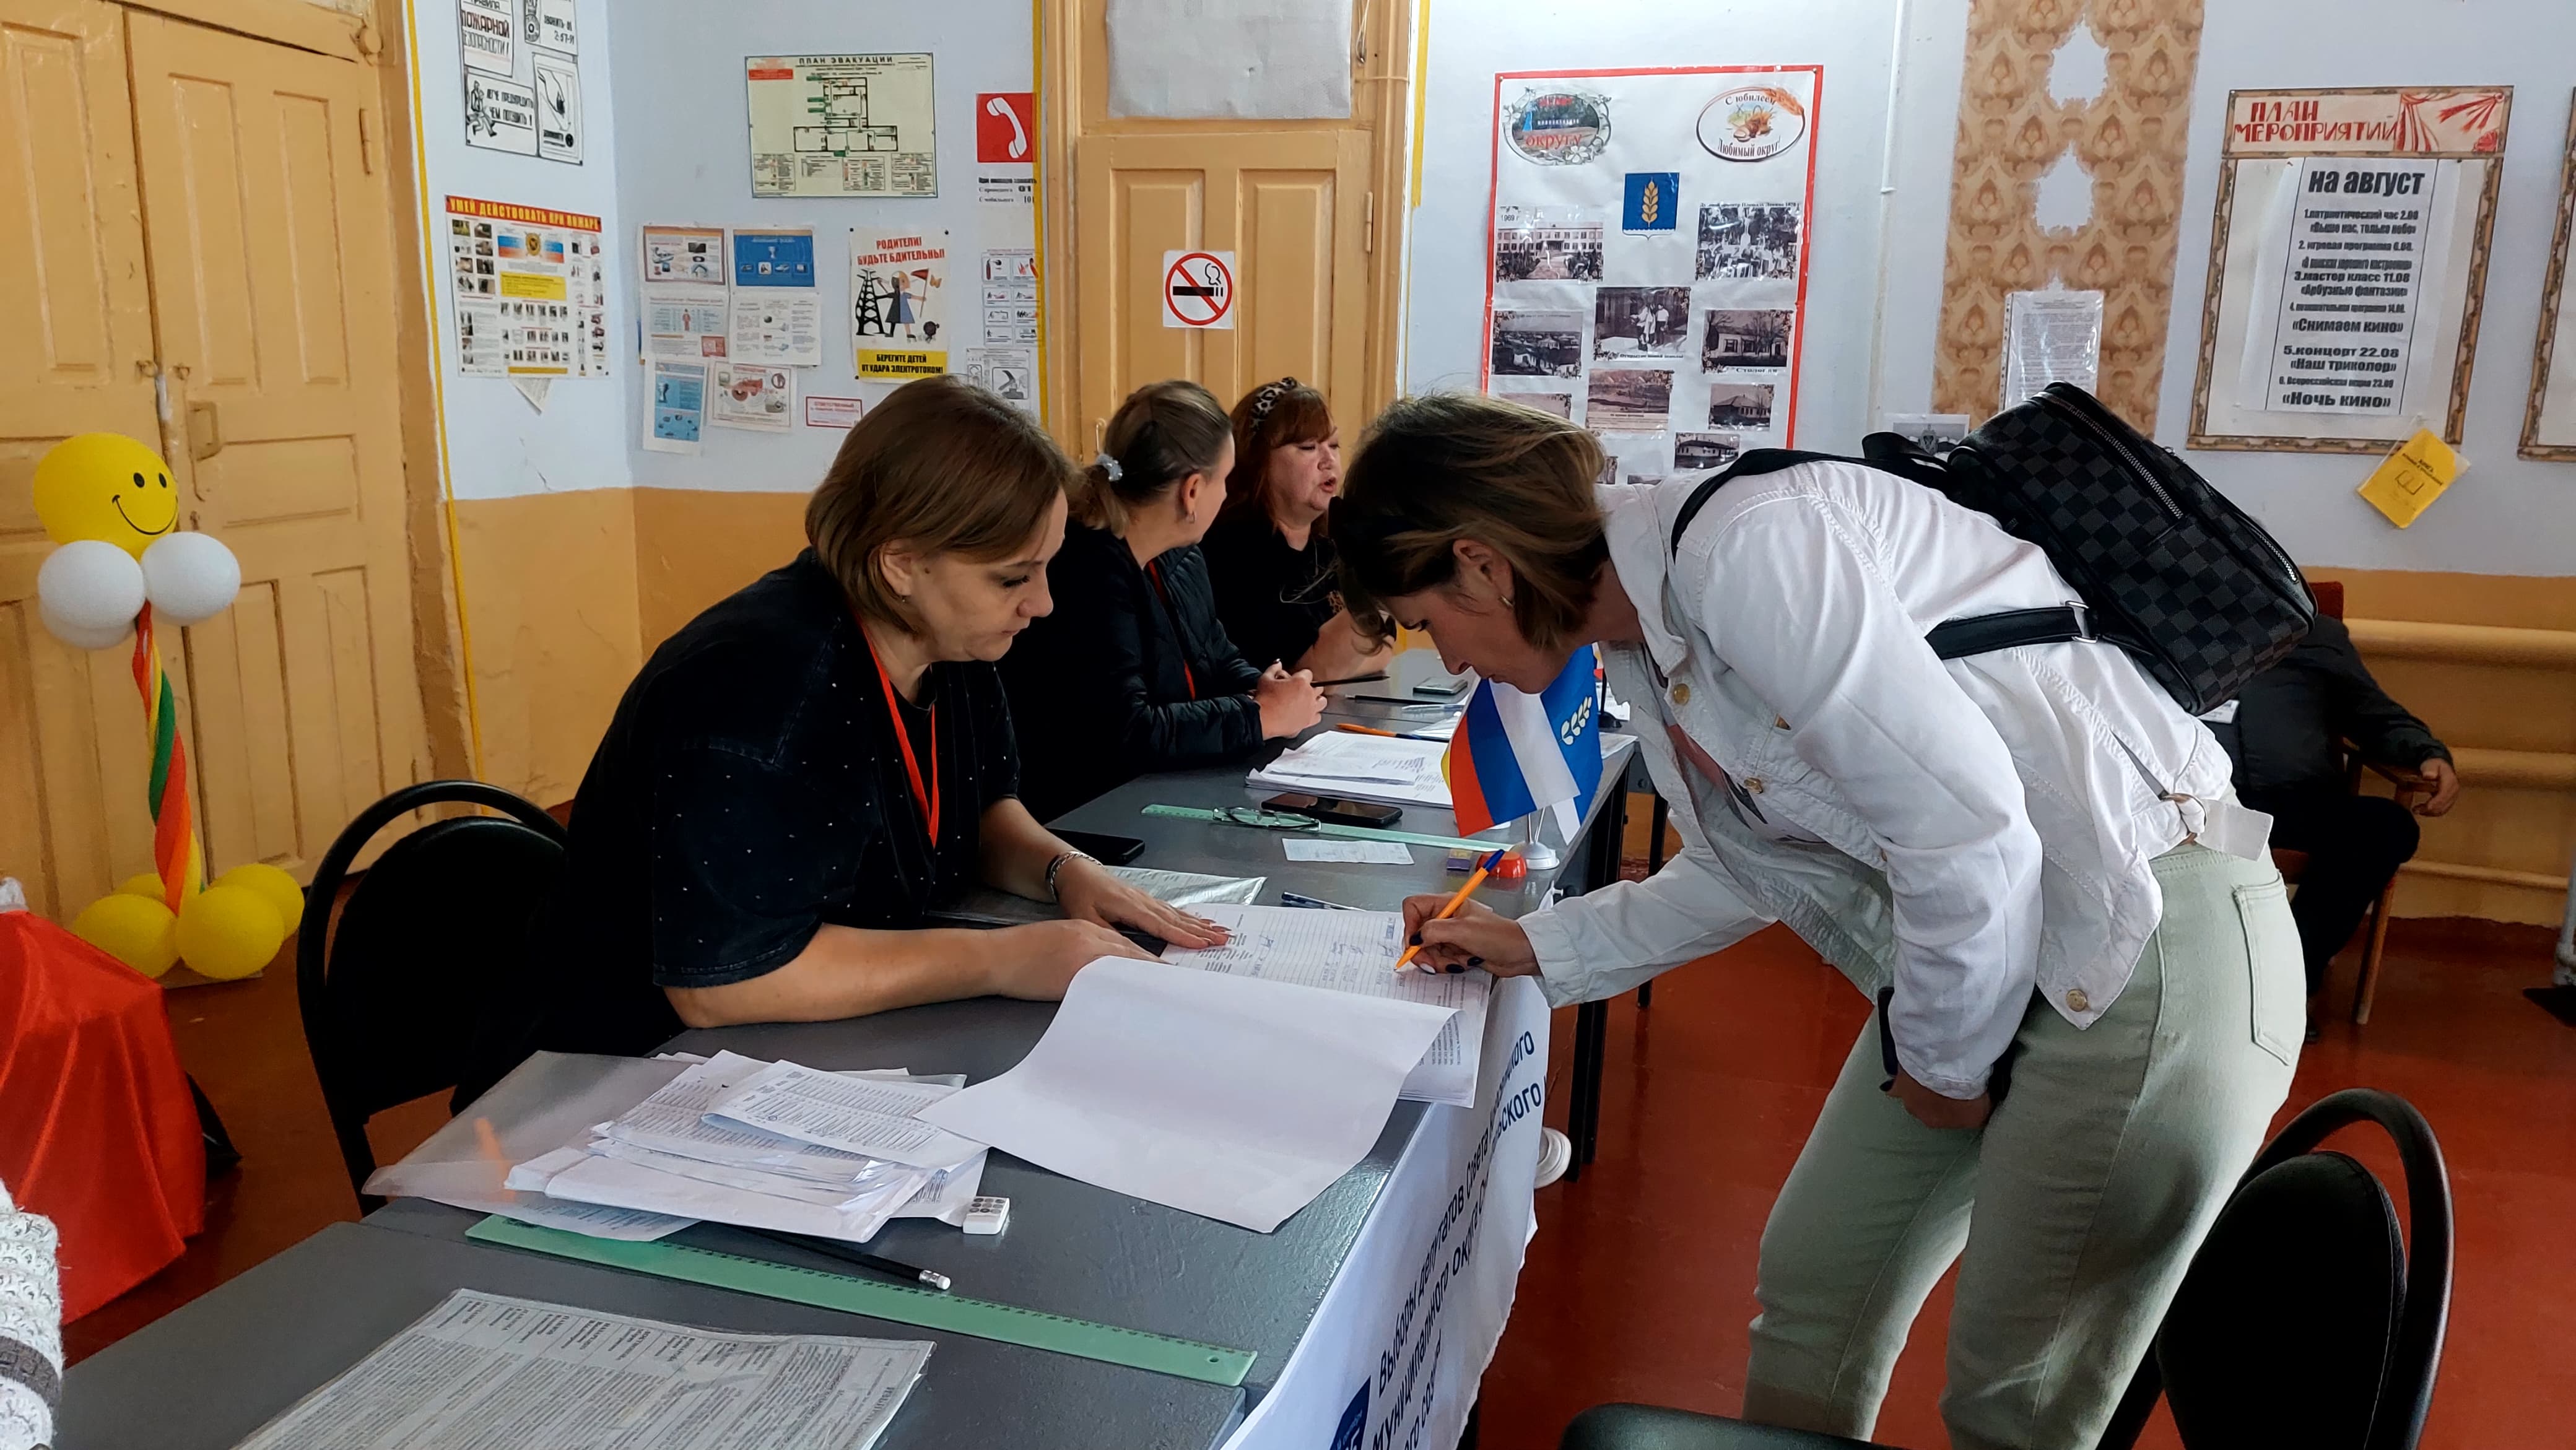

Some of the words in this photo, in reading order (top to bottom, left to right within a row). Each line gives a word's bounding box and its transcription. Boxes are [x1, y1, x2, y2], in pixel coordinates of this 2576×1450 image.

[830, 56, 893, 65] ЭВАКУАЦИИ
[1725, 97, 1733, 105] С
[1735, 92, 1776, 106] юбилеем
[2250, 100, 2319, 123] ПЛАН
[2233, 115, 2398, 142] МЕРОПРИЯТИЙ
[1525, 133, 1583, 150] округу
[1718, 137, 1755, 157] Любимый
[2308, 170, 2340, 193] на
[2343, 171, 2426, 198] август
[450, 198, 476, 214] УМЕЙ
[479, 202, 547, 223] ДЕЙСТВОВАТЬ
[549, 212, 565, 225] ПРИ
[567, 214, 599, 230] ПОЖАРЕ
[876, 236, 922, 250] РОДИТЕЛИ!
[857, 253, 888, 266] БУДЬТЕ
[889, 248, 945, 263] БДИТЕЛЬНЫ!
[2347, 273, 2381, 282] класс
[2383, 272, 2410, 282] 11.08
[2363, 321, 2403, 333] кино»
[876, 354, 906, 363] БЕРЕГИТЕ
[907, 354, 927, 363] ДЕТЕЙ
[2359, 347, 2400, 358] 22.08
[861, 363, 869, 372] ОТ
[869, 364, 890, 373] УДАРА
[890, 365, 944, 374] ЭЛЕКТРОТОКОМ!
[2291, 358, 2326, 370] «Наш
[2328, 360, 2397, 373] триколор»
[2282, 391, 2336, 406] «Ночь
[2339, 395, 2391, 407] кино»
[1378, 1280, 1418, 1399] Выборы
[1417, 1183, 1465, 1306] депутатов
